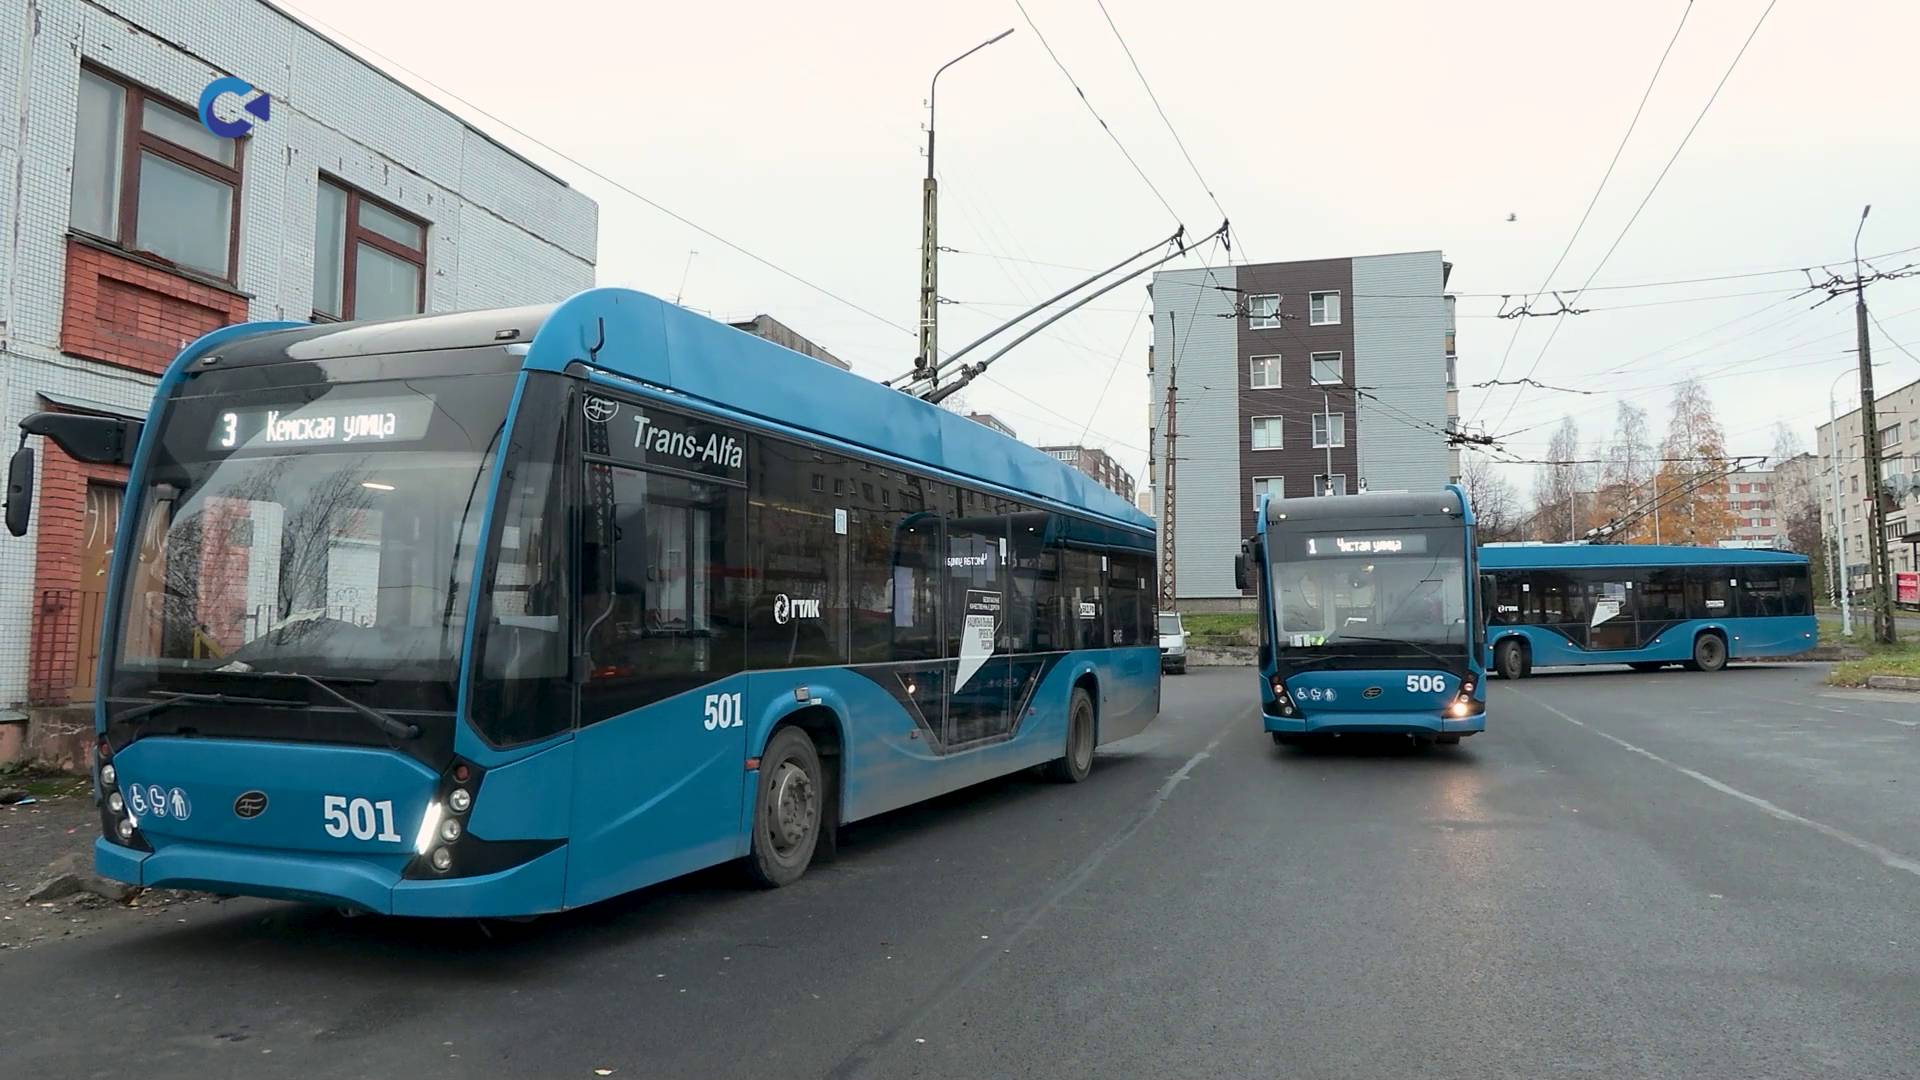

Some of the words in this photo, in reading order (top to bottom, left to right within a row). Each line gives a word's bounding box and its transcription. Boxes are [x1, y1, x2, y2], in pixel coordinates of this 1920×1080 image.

[221, 412, 237, 446] 3
[266, 411, 335, 441] Кемская
[343, 413, 395, 441] улица
[634, 415, 743, 468] Trans-Alfa
[1308, 539, 1317, 554] 1
[791, 599, 820, 619] ГТЛК
[1407, 674, 1446, 693] 506
[704, 693, 744, 731] 501
[324, 795, 401, 843] 501
